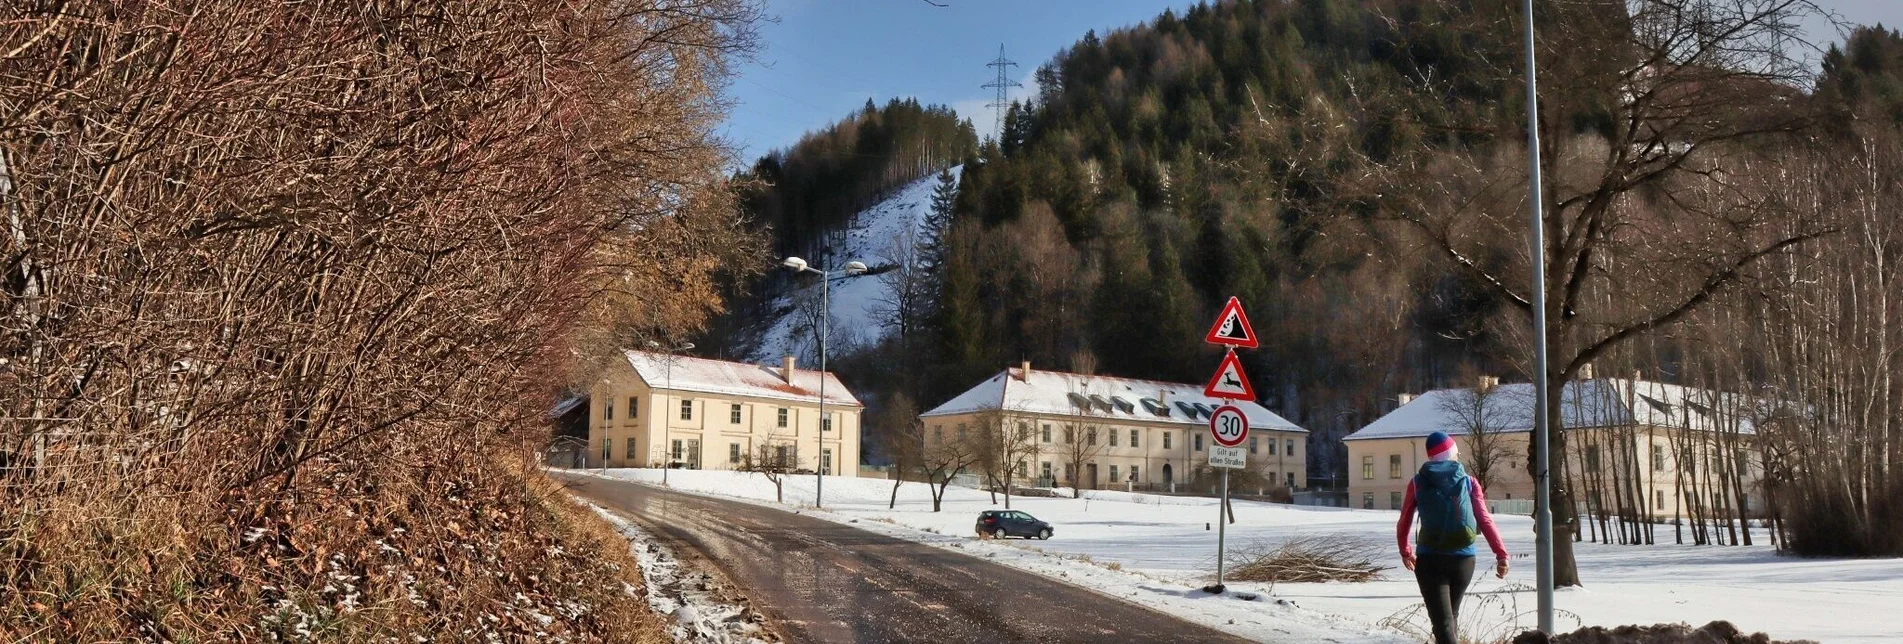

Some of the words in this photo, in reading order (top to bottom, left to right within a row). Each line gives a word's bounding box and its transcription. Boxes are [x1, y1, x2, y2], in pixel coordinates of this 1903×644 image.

[1219, 415, 1240, 436] 30
[1217, 448, 1227, 456] Gilt
[1224, 458, 1244, 466] Straßen
